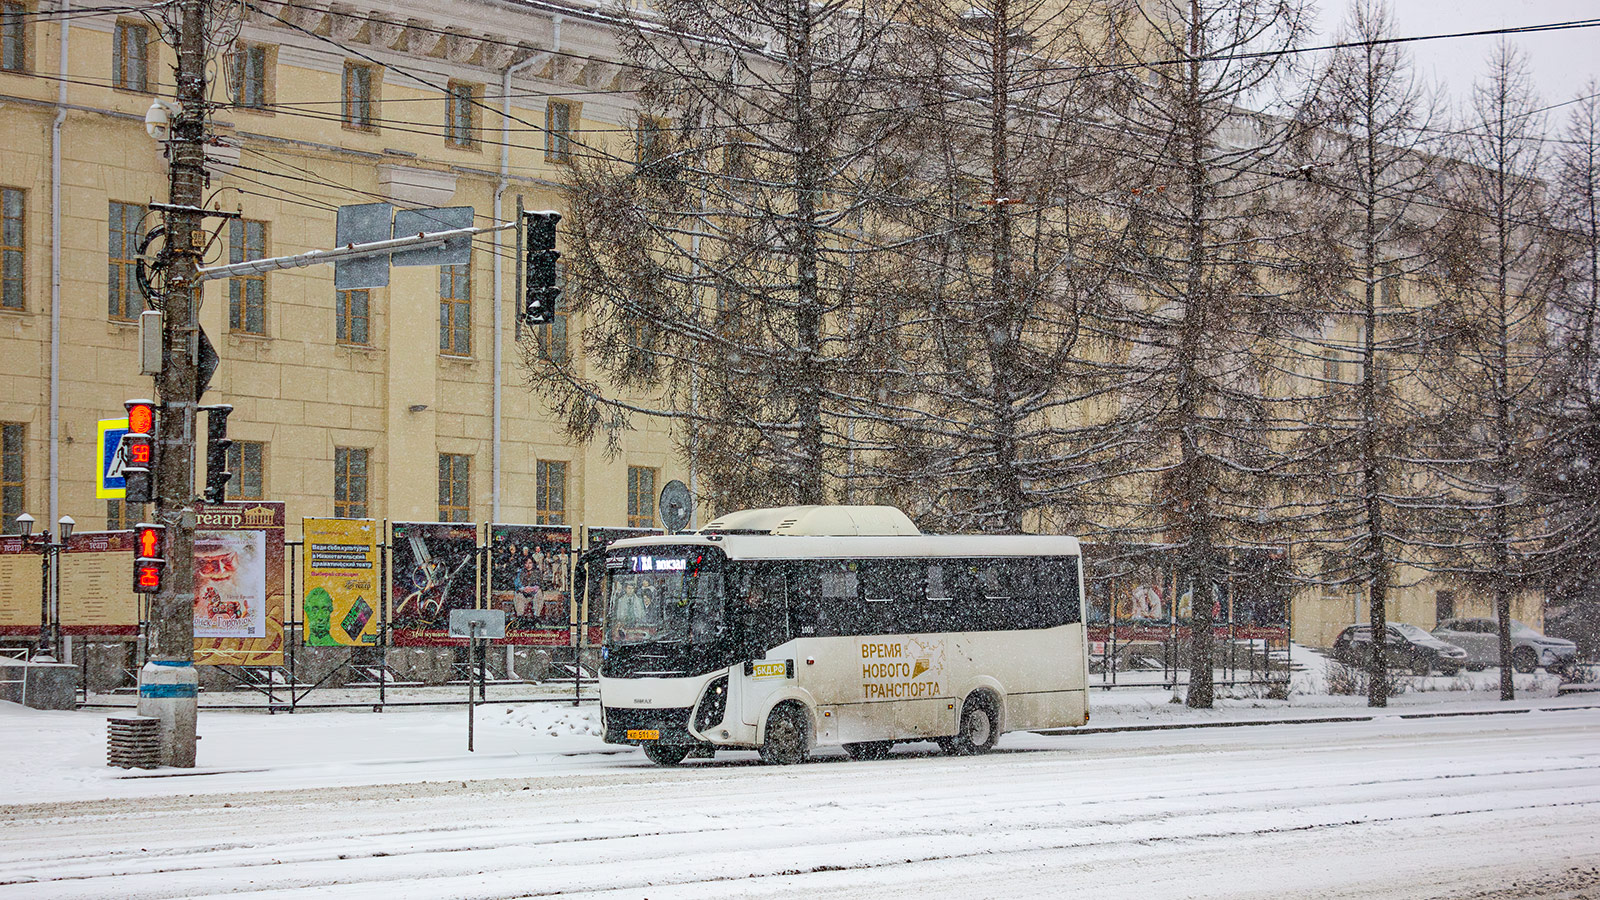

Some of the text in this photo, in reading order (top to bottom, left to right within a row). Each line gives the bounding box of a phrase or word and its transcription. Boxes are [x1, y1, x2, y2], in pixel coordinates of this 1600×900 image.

[195, 514, 242, 529] театр
[862, 643, 902, 658] ВРЕМЯ
[757, 664, 784, 675] БКД.РФ
[863, 663, 910, 678] НОВОГО
[863, 682, 940, 698] ТРАНСПОРТА
